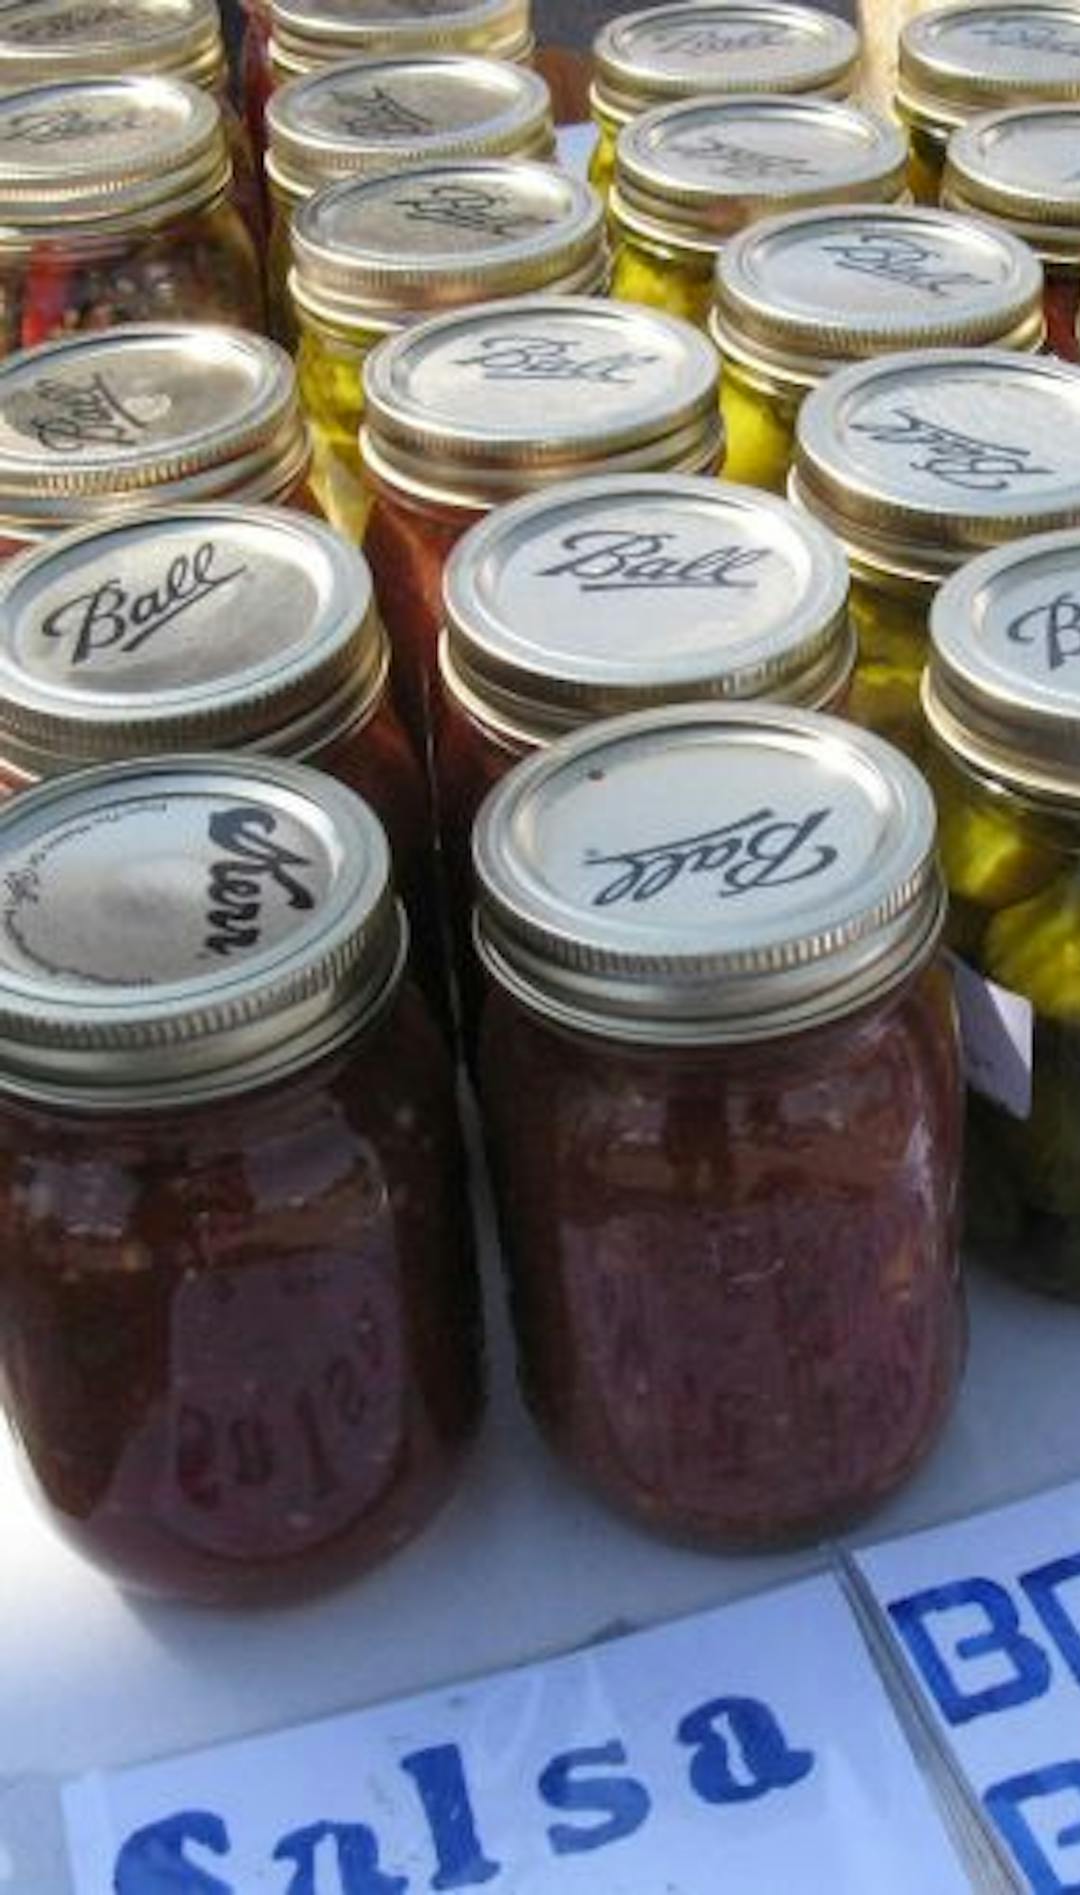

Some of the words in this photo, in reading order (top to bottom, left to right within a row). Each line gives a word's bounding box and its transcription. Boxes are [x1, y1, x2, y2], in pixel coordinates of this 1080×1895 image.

[455, 334, 662, 384] Ball
[850, 408, 1056, 492] Ball
[42, 542, 248, 666] Ball
[538, 530, 772, 592] Ball
[205, 806, 316, 956] Kerr
[585, 808, 840, 906] Ball
